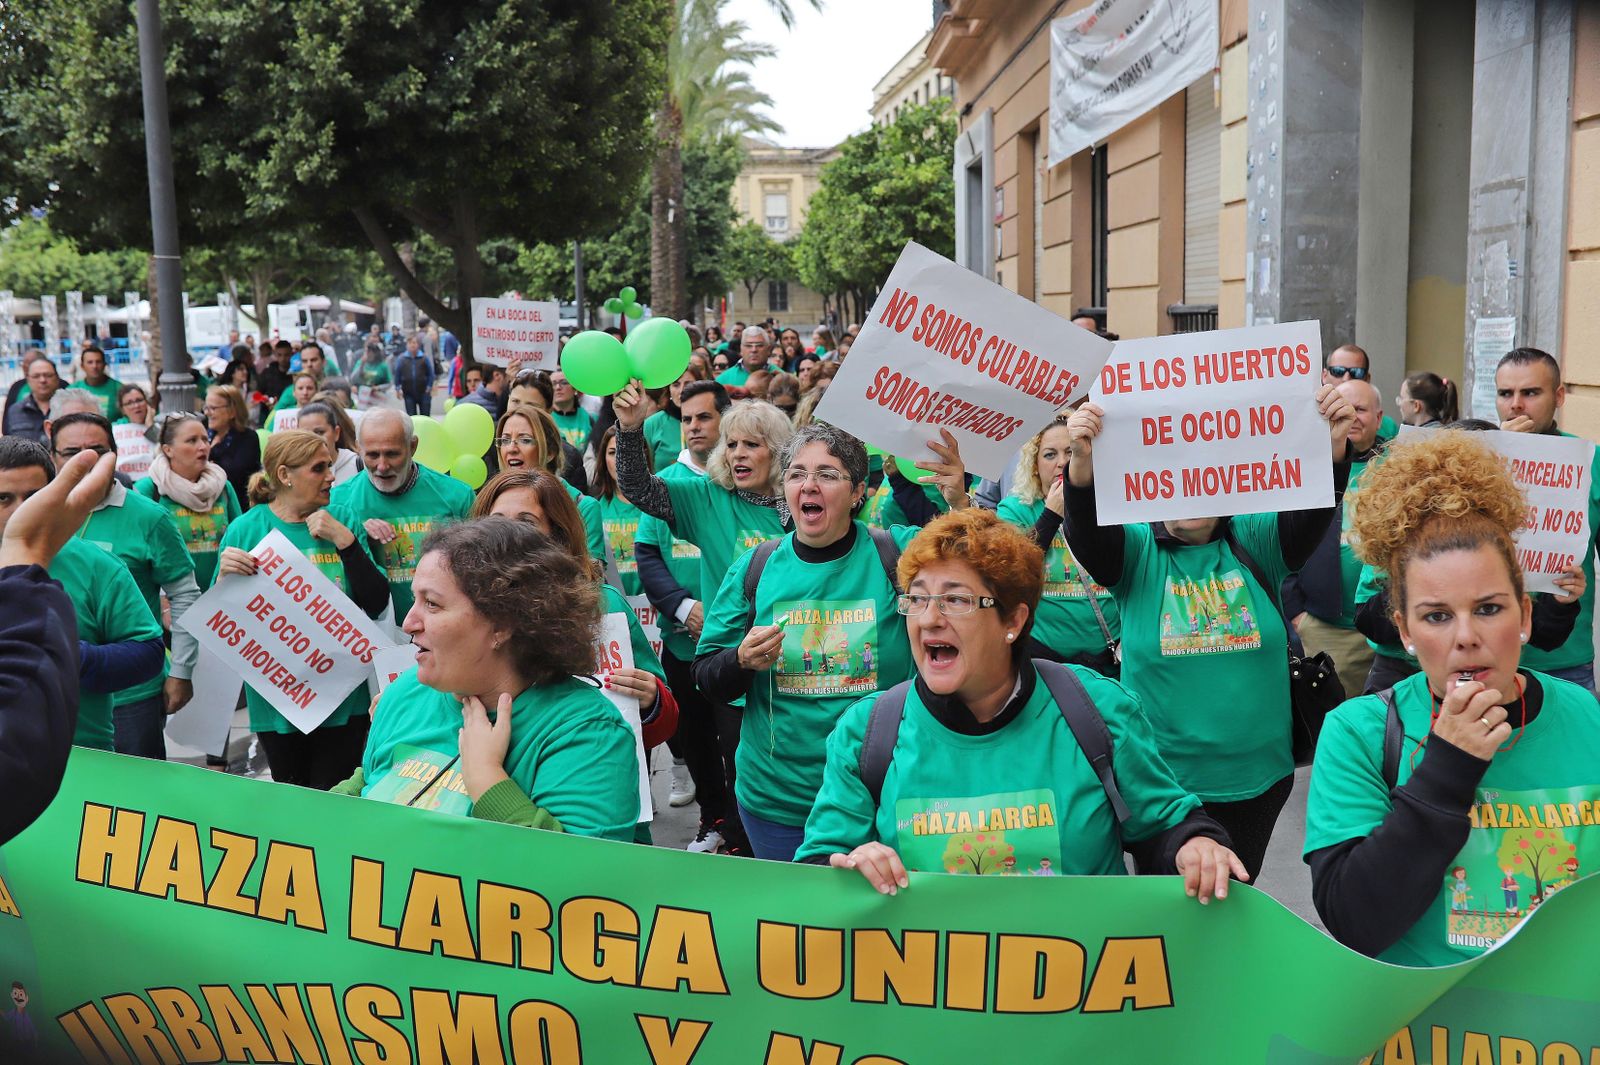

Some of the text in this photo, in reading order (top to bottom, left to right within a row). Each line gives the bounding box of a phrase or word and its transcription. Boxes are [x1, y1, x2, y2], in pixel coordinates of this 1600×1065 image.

[477, 326, 554, 342] MENTIROSO LO CIERTO
[486, 307, 542, 322] EN LA BOCA DEL
[879, 287, 919, 333] NO
[912, 303, 983, 366] SOMOS
[486, 347, 496, 358] SE
[1100, 343, 1311, 395] DE LOS HUERTOS
[865, 366, 1024, 442] SOMOS ESTAFADOS
[1141, 404, 1285, 446] DE OCIO NO
[1124, 453, 1302, 502] NOS MOVERÁN
[1511, 458, 1574, 490] PARCELAS
[1575, 465, 1584, 490] Y
[1542, 508, 1564, 532] NO
[1565, 510, 1584, 536] OS
[254, 547, 378, 665] DE LOS HUERTOS
[824, 607, 875, 625] LARGA
[246, 593, 335, 674] DE OCIO NO
[206, 610, 317, 710] NOS MOVERÁN
[814, 686, 848, 694] NUESTROS
[848, 683, 878, 692] HUERTOS
[912, 803, 1054, 836] HAZA LARGA
[75, 801, 1175, 1014] HAZA LARGA UNIDA
[1448, 933, 1494, 948] UNIDOS
[55, 982, 583, 1065] URBANISMO
